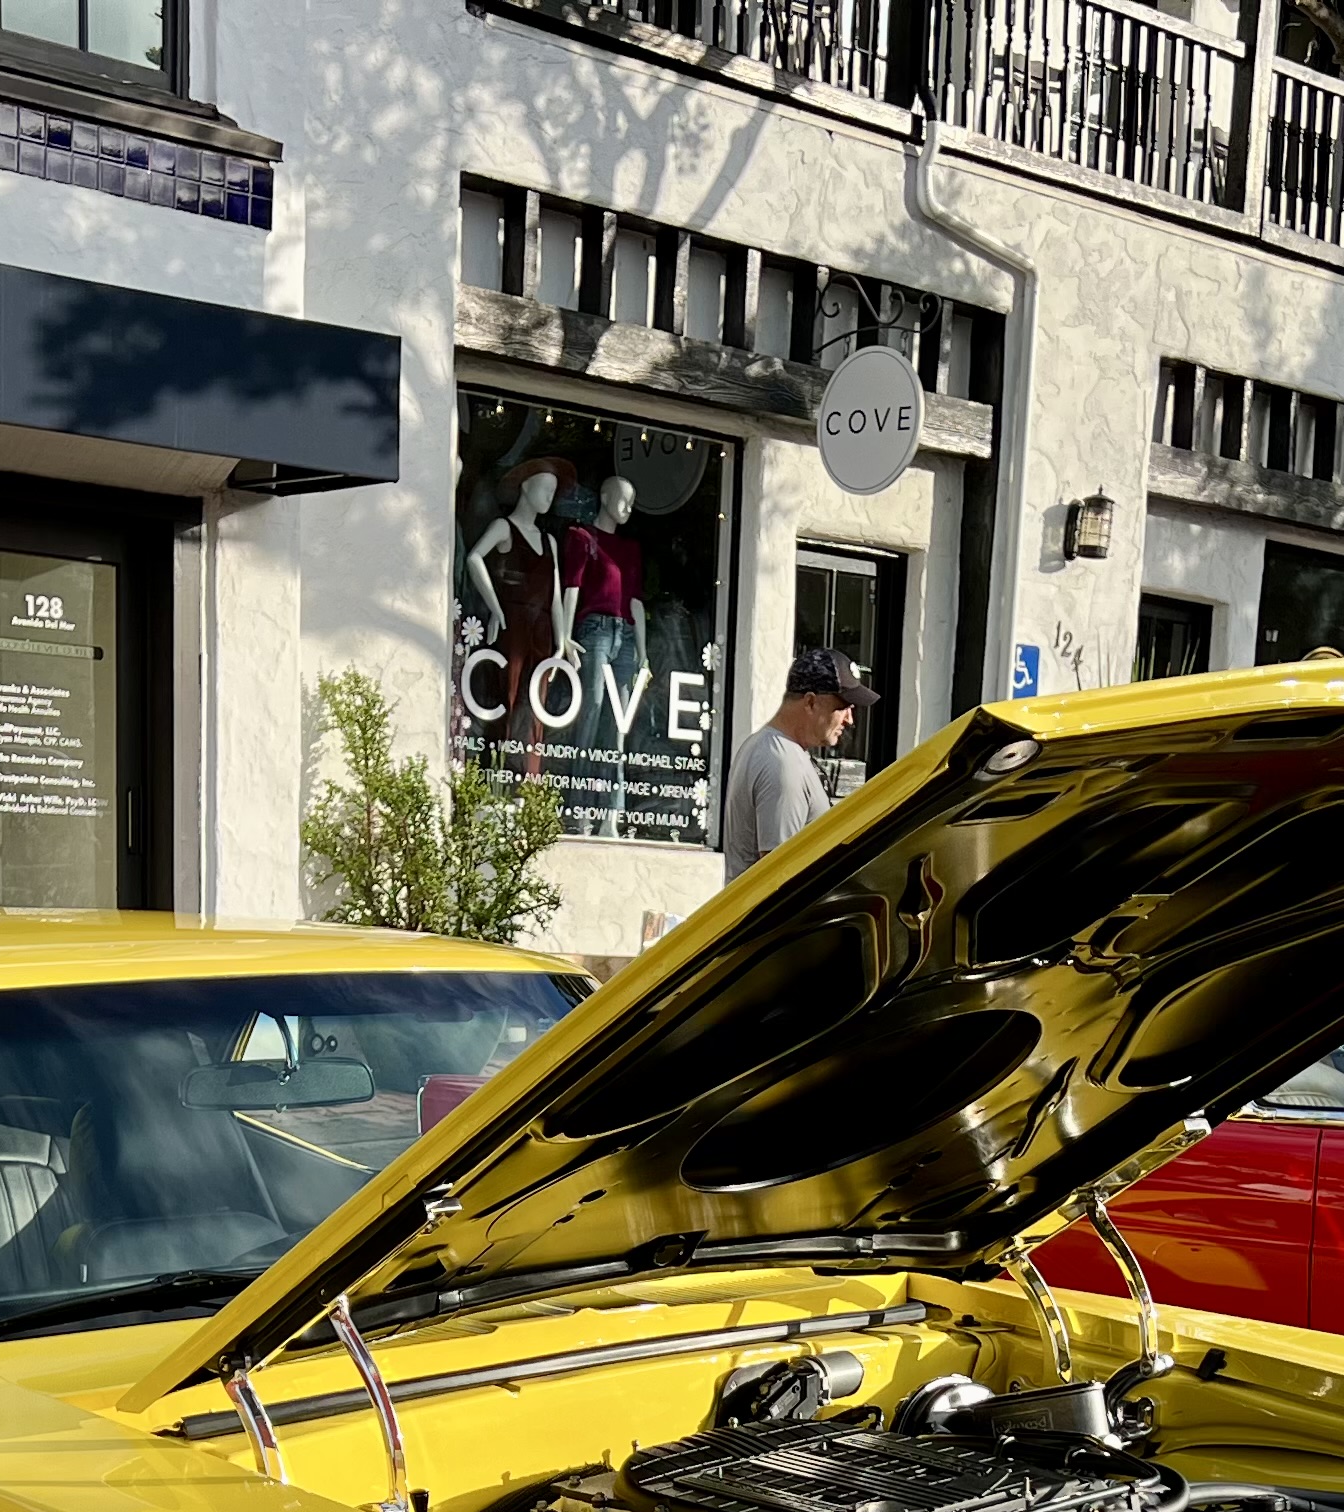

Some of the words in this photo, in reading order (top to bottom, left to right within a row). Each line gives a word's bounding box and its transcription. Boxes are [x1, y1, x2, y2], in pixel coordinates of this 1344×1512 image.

[826, 406, 911, 435] COVE
[25, 594, 63, 619] 128
[1054, 620, 1083, 672] 124
[461, 648, 704, 741] COVE
[454, 736, 485, 751] RAILS
[535, 742, 579, 759] SUNDRY
[588, 748, 619, 763] VINCE
[628, 752, 673, 769] MICHAEL
[674, 756, 707, 772] STARS
[623, 781, 651, 796] PAIGE
[573, 806, 607, 820] SHOW
[627, 811, 655, 826] YOUR
[655, 813, 690, 828] MUMU
